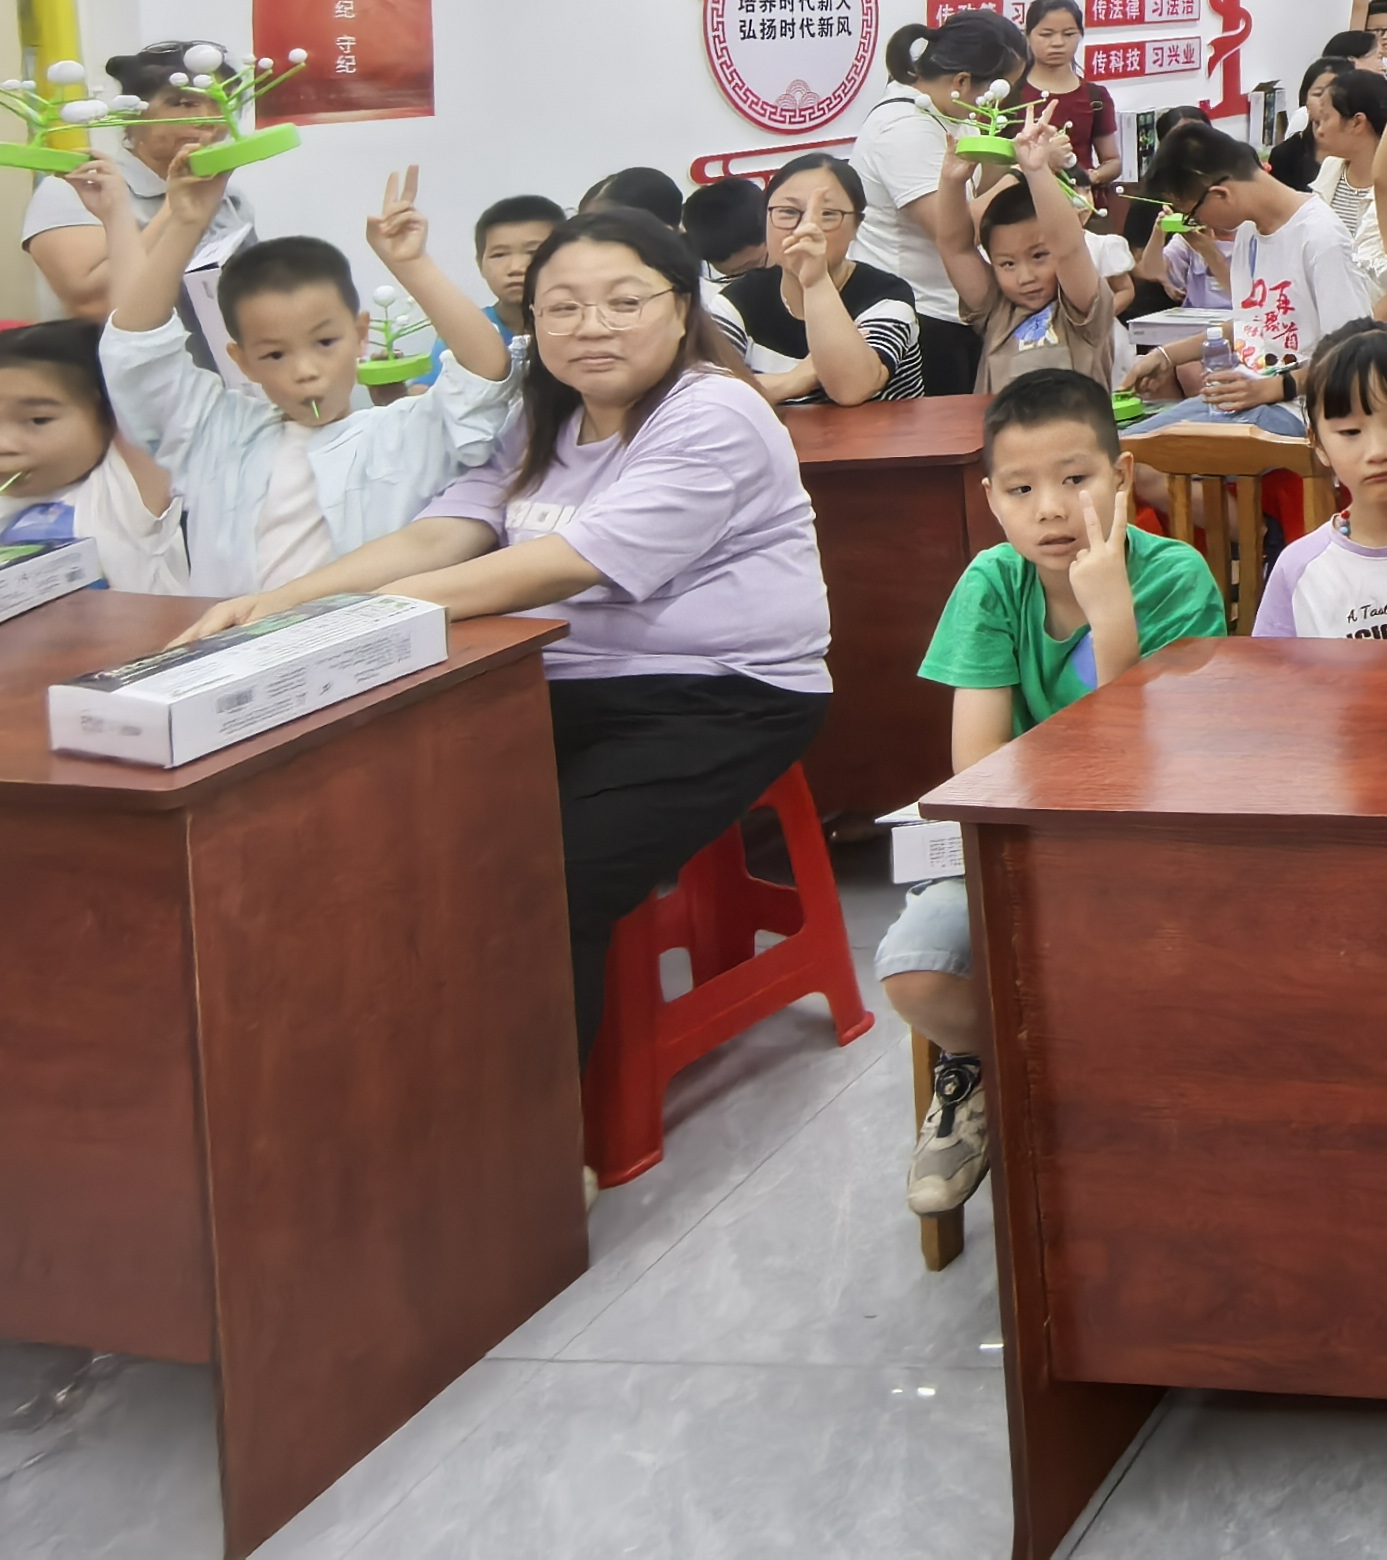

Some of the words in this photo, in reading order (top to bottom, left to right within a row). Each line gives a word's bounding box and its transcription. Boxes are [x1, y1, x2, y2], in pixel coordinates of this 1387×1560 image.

[738, 15, 853, 41] 弘扬时代新风
[336, 35, 356, 74] 守纪
[1092, 47, 1141, 75] 传科技
[1151, 43, 1196, 68] 习兴业
[1346, 609, 1358, 624] A
